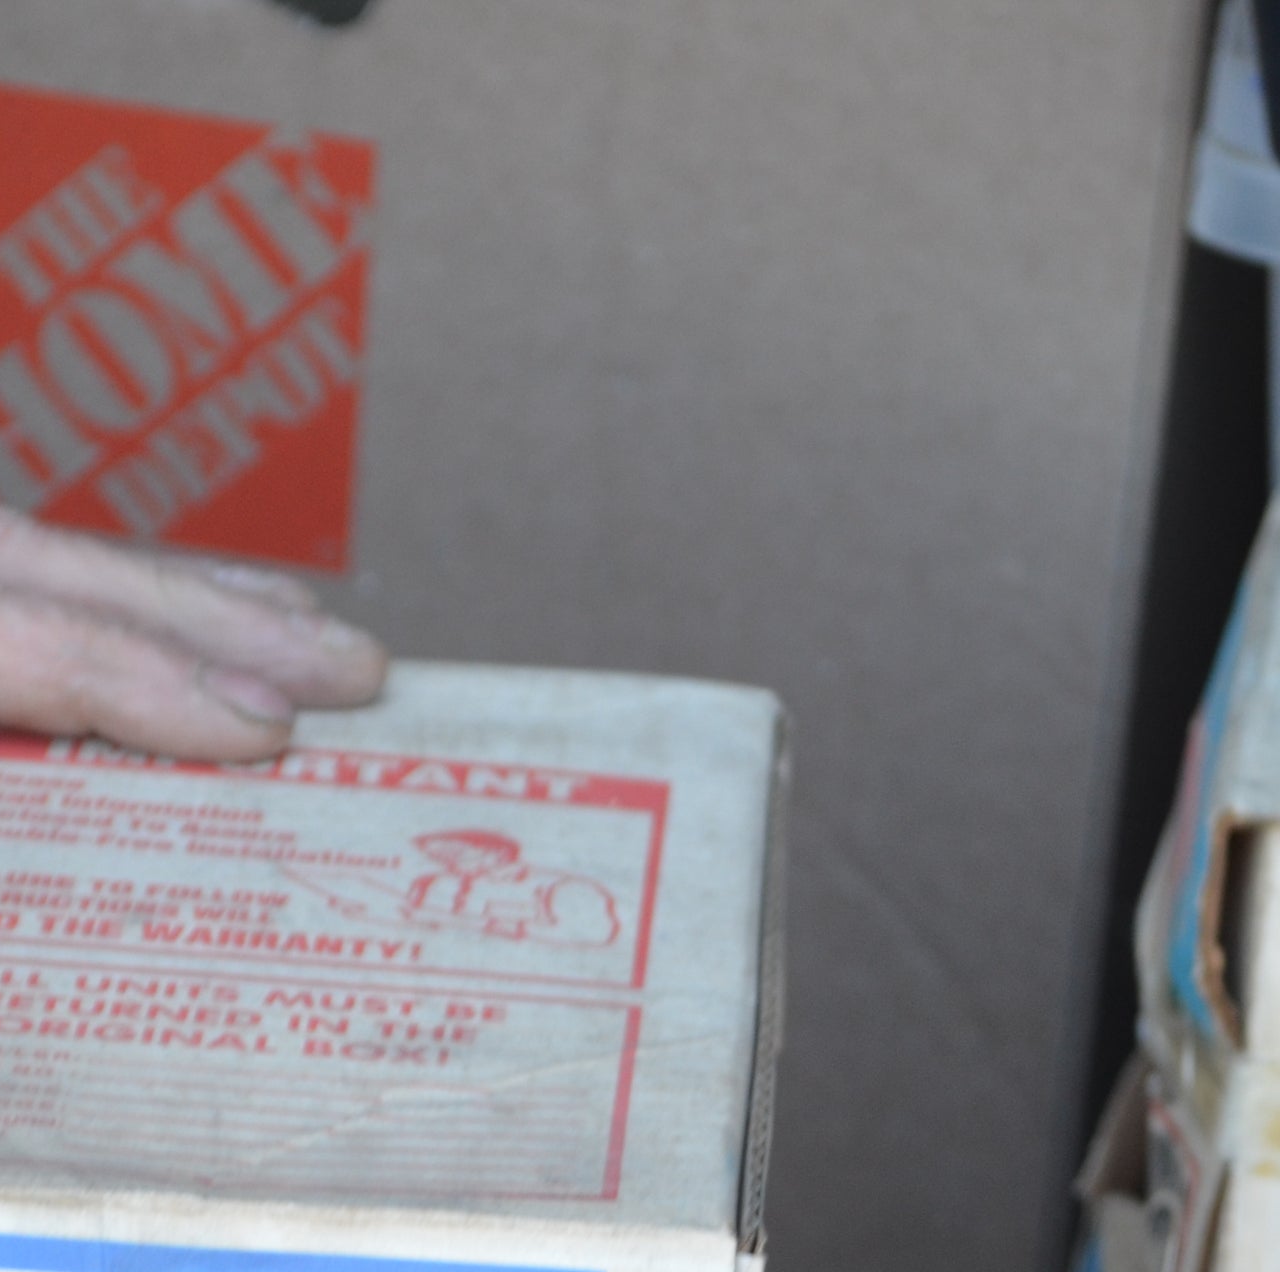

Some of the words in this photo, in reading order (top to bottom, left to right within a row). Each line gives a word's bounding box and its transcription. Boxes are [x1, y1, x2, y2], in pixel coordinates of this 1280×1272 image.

[98, 300, 361, 543] DEPOT
[59, 793, 267, 824] Information
[179, 822, 299, 845] Assure
[90, 880, 136, 897] TO
[144, 883, 293, 909] FOLLOW
[193, 903, 275, 925] WILL
[37, 913, 126, 940] THE
[141, 921, 426, 963] WARRANTY!
[74, 973, 242, 1004] UNITS
[262, 987, 421, 1019] MUST
[444, 1003, 509, 1024] BE
[287, 1012, 352, 1036] IN
[376, 1020, 479, 1045] THE
[302, 1037, 455, 1068] BOX!
